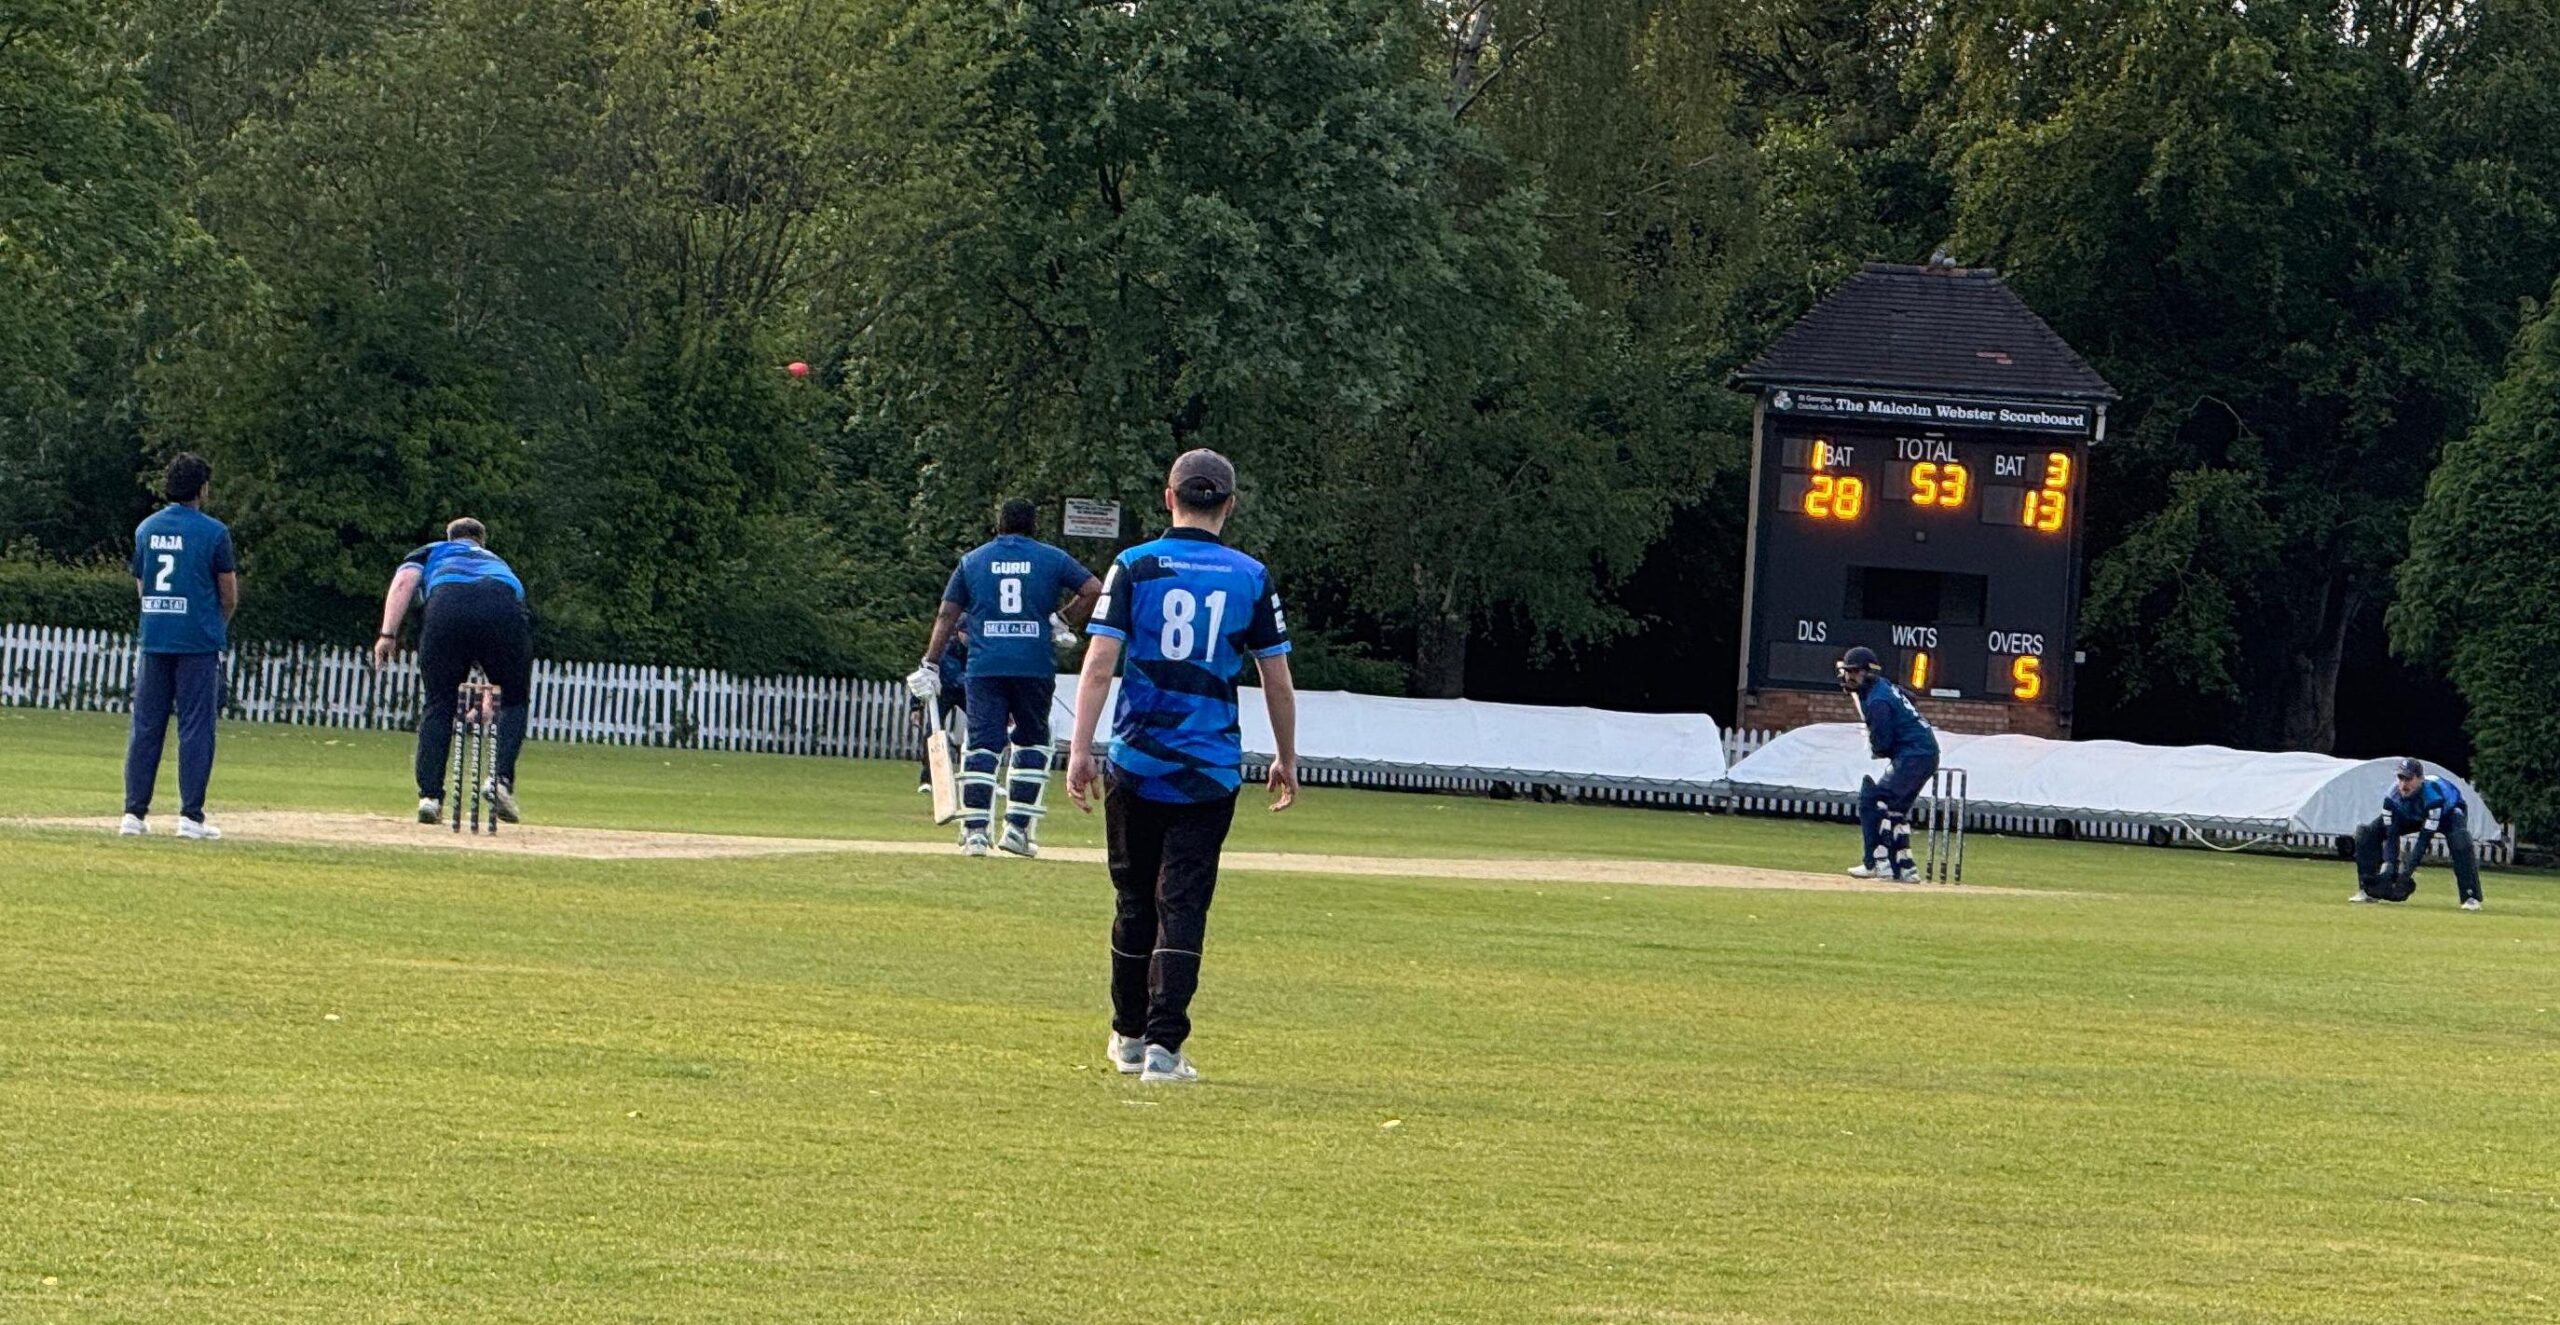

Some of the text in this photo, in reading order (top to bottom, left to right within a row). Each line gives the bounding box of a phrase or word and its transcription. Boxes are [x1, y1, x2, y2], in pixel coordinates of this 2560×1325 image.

[1836, 398, 2084, 427] The Malcolm Webster Scoreboard
[1812, 440, 1825, 470] 1
[1825, 445, 1854, 467] BAT
[1896, 437, 1960, 462] TOTAL
[1995, 454, 2026, 476] BAT
[2045, 452, 2070, 488] 3
[1805, 475, 1863, 519] 28
[1912, 462, 1967, 506] 53
[2023, 488, 2066, 531] 13
[150, 534, 183, 550] RAJA
[156, 554, 174, 591] 2
[991, 561, 1031, 574] GURU
[1000, 578, 1022, 613] 8
[1160, 588, 1228, 663] 81
[1798, 620, 1827, 642] DLS
[1892, 624, 1938, 649] WKTS
[1988, 630, 2044, 655] OVERS
[1912, 652, 1928, 689] 1
[2012, 655, 2041, 699] 5
